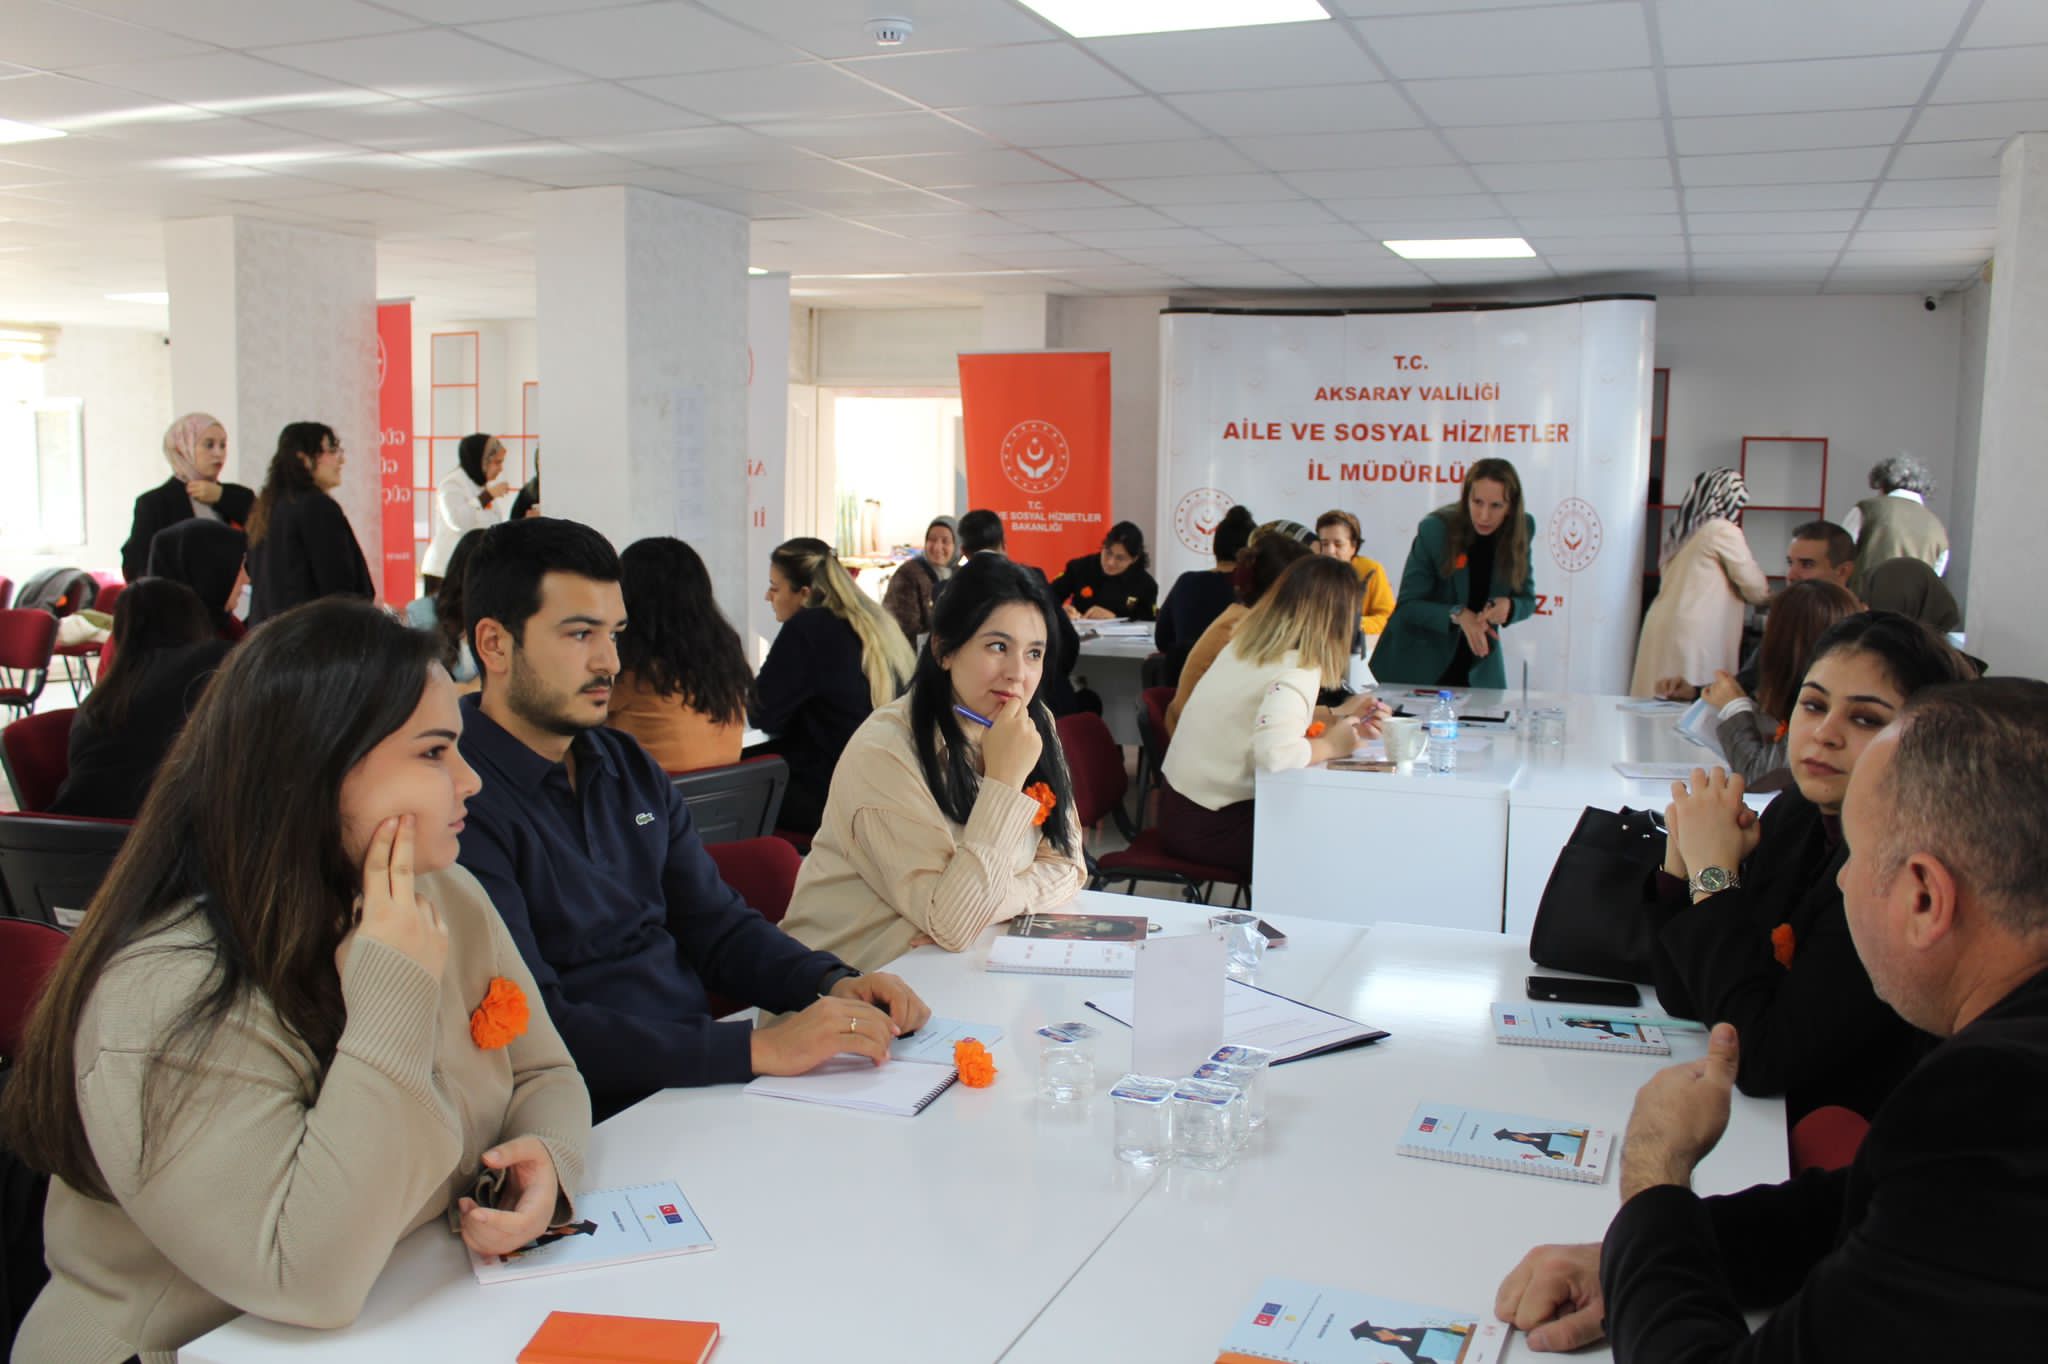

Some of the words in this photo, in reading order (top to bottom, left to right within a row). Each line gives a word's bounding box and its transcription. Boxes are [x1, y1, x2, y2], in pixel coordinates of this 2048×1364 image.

[1393, 354, 1429, 371] T.C.
[1314, 386, 1412, 401] AKSARAY
[1418, 383, 1500, 401] VALİLİĞİ
[1223, 418, 1281, 441] AİLE
[1291, 423, 1326, 442] VE
[1334, 422, 1433, 443] SOSYAL
[1442, 419, 1569, 444] HİZMETLER
[1308, 459, 1331, 481] İL
[1340, 460, 1465, 485] MÜDÜRLÜ
[1010, 511, 1044, 522] SOSYAL
